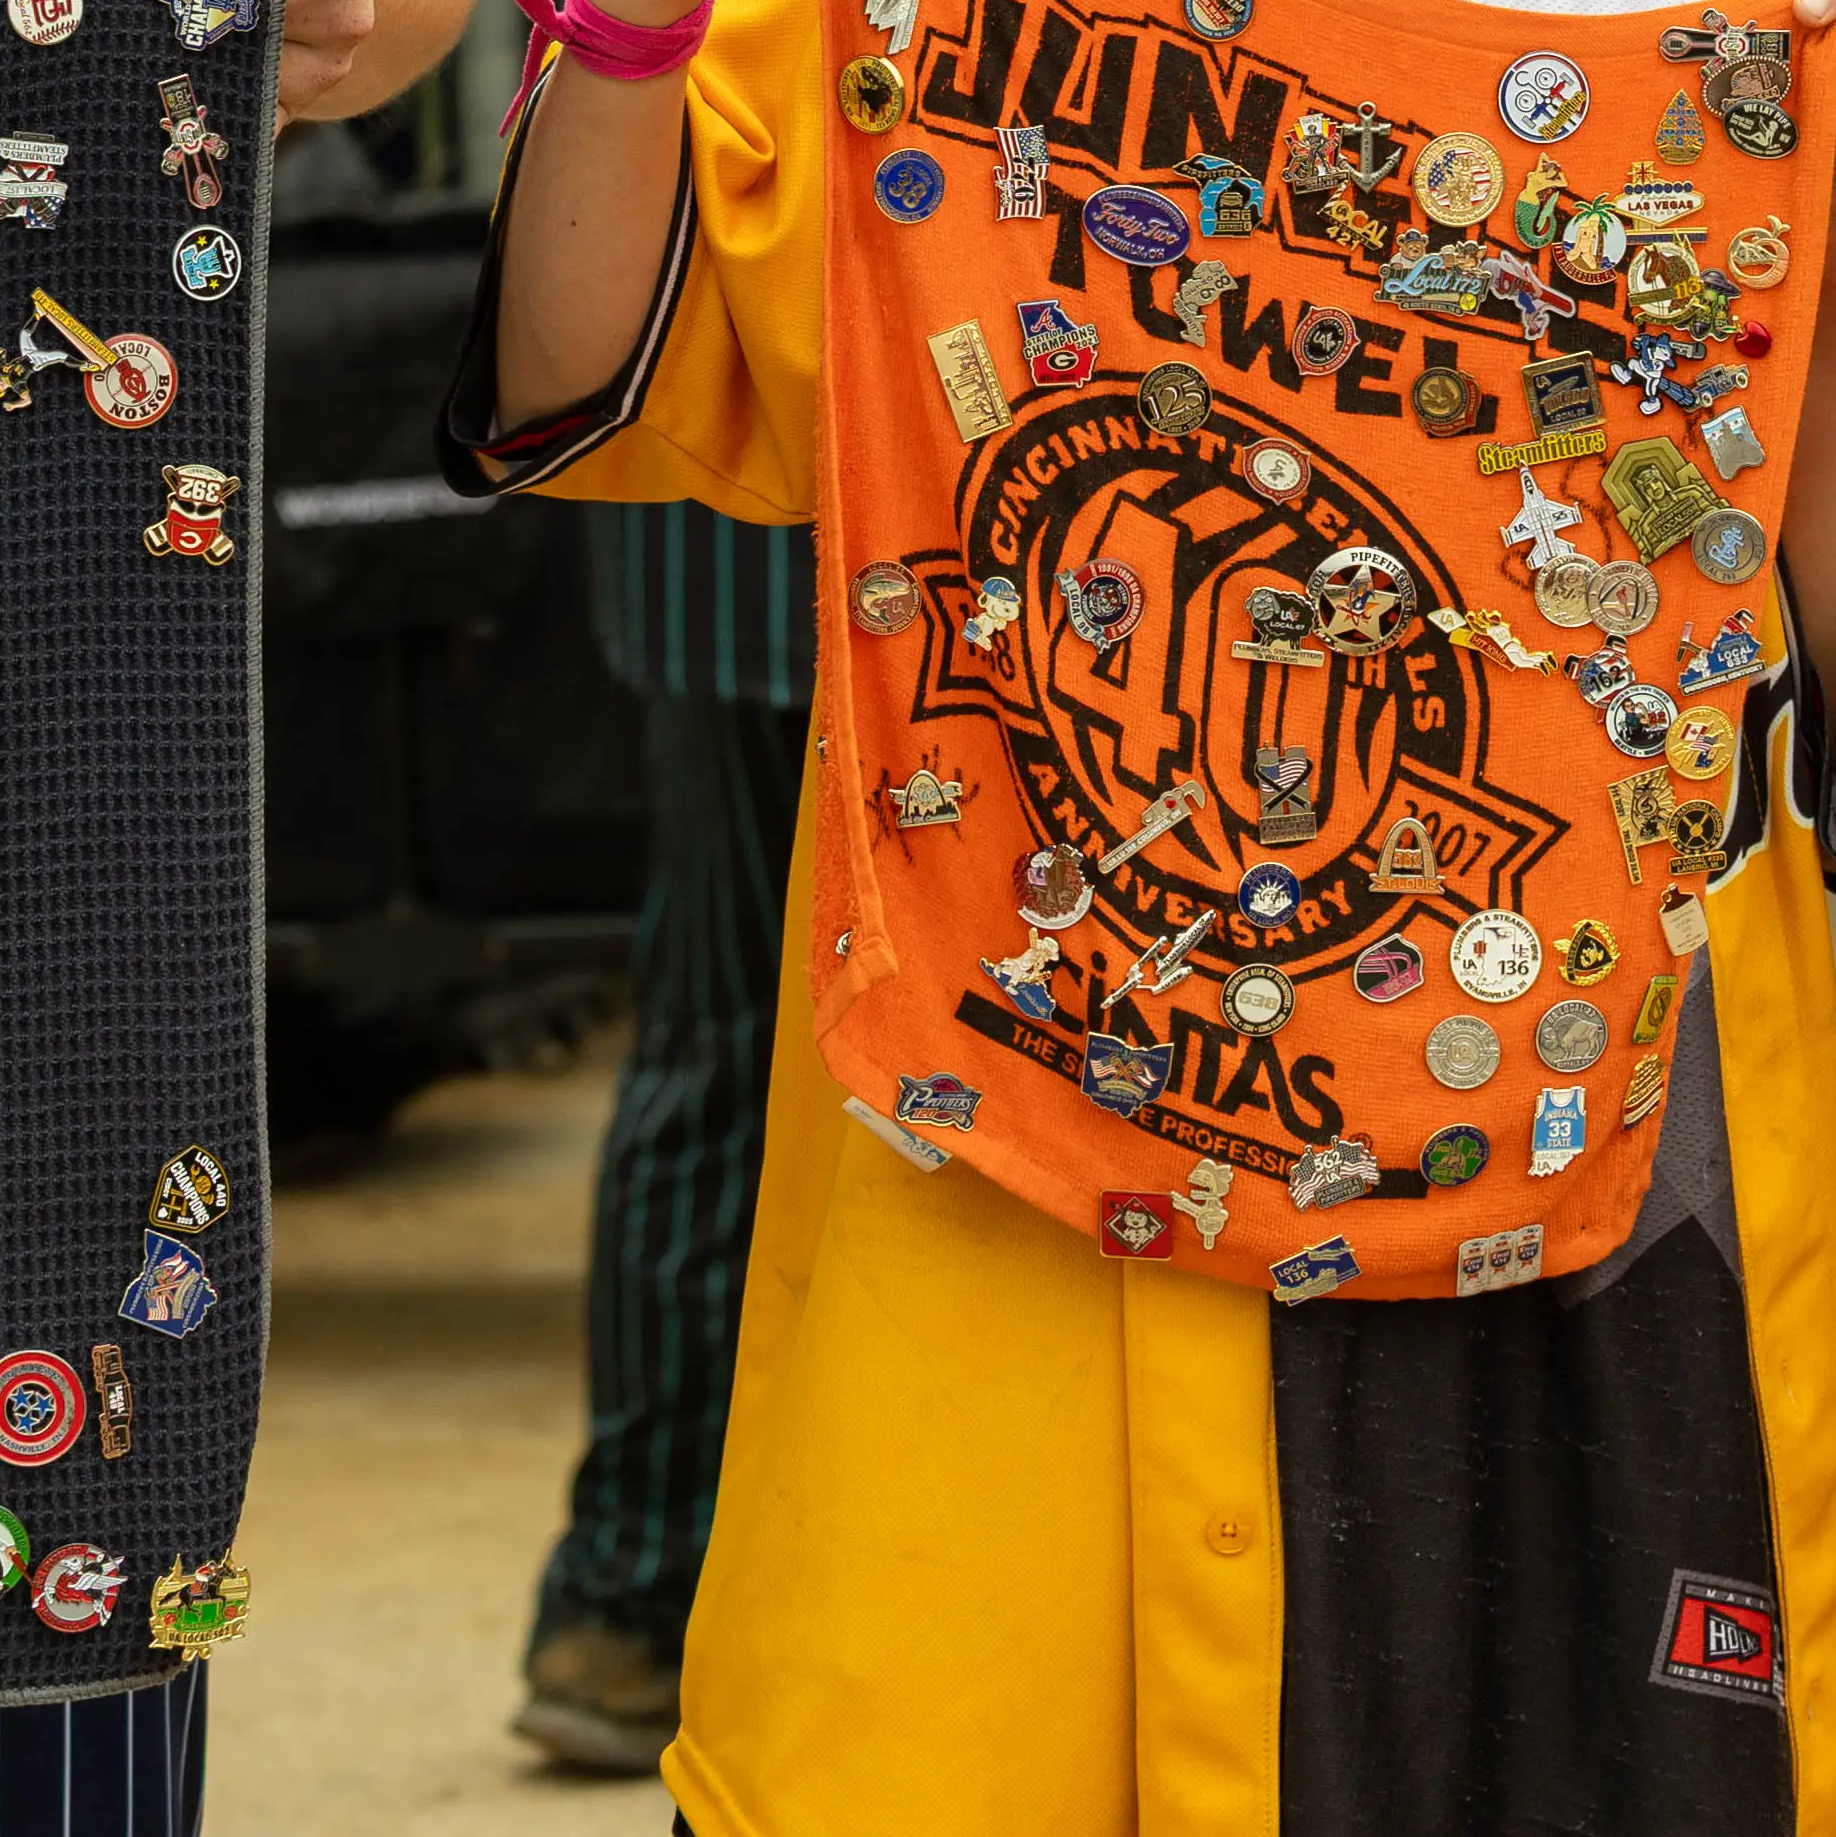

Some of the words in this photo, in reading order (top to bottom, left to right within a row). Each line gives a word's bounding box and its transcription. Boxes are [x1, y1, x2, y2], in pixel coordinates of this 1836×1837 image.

[1539, 90, 1587, 140] Steamfitters
[1744, 103, 1757, 113] WE
[1759, 104, 1774, 116] LAY
[1773, 111, 1792, 129] PIPE
[0, 140, 68, 156] STEAMFITTERS
[14, 148, 63, 164] PLUMBERS
[1182, 164, 1241, 178] PIPEFITTERS
[888, 169, 927, 209] 38
[1219, 209, 1251, 220] 636
[1627, 202, 1650, 211] LAS
[1654, 200, 1694, 210] VEGAS
[1326, 226, 1359, 251] 421
[1148, 248, 1165, 260] OH
[1385, 253, 1450, 295] Local
[1452, 276, 1481, 295] 172
[1674, 276, 1703, 300] 113
[67, 319, 118, 362] STEAMFITTERS
[1023, 325, 1095, 359] CHAMPIONS
[1027, 335, 1048, 346] STATE
[1076, 338, 1099, 350] 2021
[108, 374, 171, 420] BOSTON
[1145, 377, 1206, 425] 125
[1550, 410, 1574, 424] LOCAL
[1478, 429, 1607, 477] Steamfitters
[179, 476, 222, 503] 392
[1658, 515, 1683, 535] LOCAL
[1069, 587, 1083, 624] LOCAL
[1077, 623, 1091, 638] 98
[1270, 620, 1294, 630] LOCAL
[1471, 634, 1486, 650] HIT
[1486, 642, 1508, 663] KING
[1717, 645, 1754, 663] LOCAL
[1589, 665, 1626, 694] 162
[1728, 663, 1763, 680] KENTUCKY
[1614, 738, 1638, 756] SEATTLE
[1683, 857, 1704, 865] LOCAL
[1246, 864, 1293, 883] PLUMBERS
[1258, 916, 1280, 925] LOCAL
[1453, 919, 1483, 962] PLUMBERS
[1462, 959, 1477, 970] UA
[1498, 960, 1530, 976] 136
[1463, 980, 1518, 999] EVANSVILLE,
[1238, 991, 1279, 1010] 638
[1558, 1001, 1584, 1014] LOCAL
[1011, 1024, 1064, 1062] THE
[1545, 1109, 1578, 1121] INDIANA
[1549, 1123, 1572, 1137] 33
[1547, 1138, 1572, 1148] STATE
[1314, 1150, 1342, 1171] 562
[194, 1151, 221, 1184] LOCAL
[215, 1183, 227, 1207] 440
[170, 1161, 211, 1226] CHAMPIONS
[1318, 1180, 1352, 1199] PLUMBERS
[1320, 1185, 1363, 1205] PIPEFITTERS
[1278, 1260, 1308, 1279] LOCAL
[1286, 1269, 1309, 1284] 136
[115, 1384, 126, 1413] LOCAL
[183, 1630, 210, 1644] LOCAL
